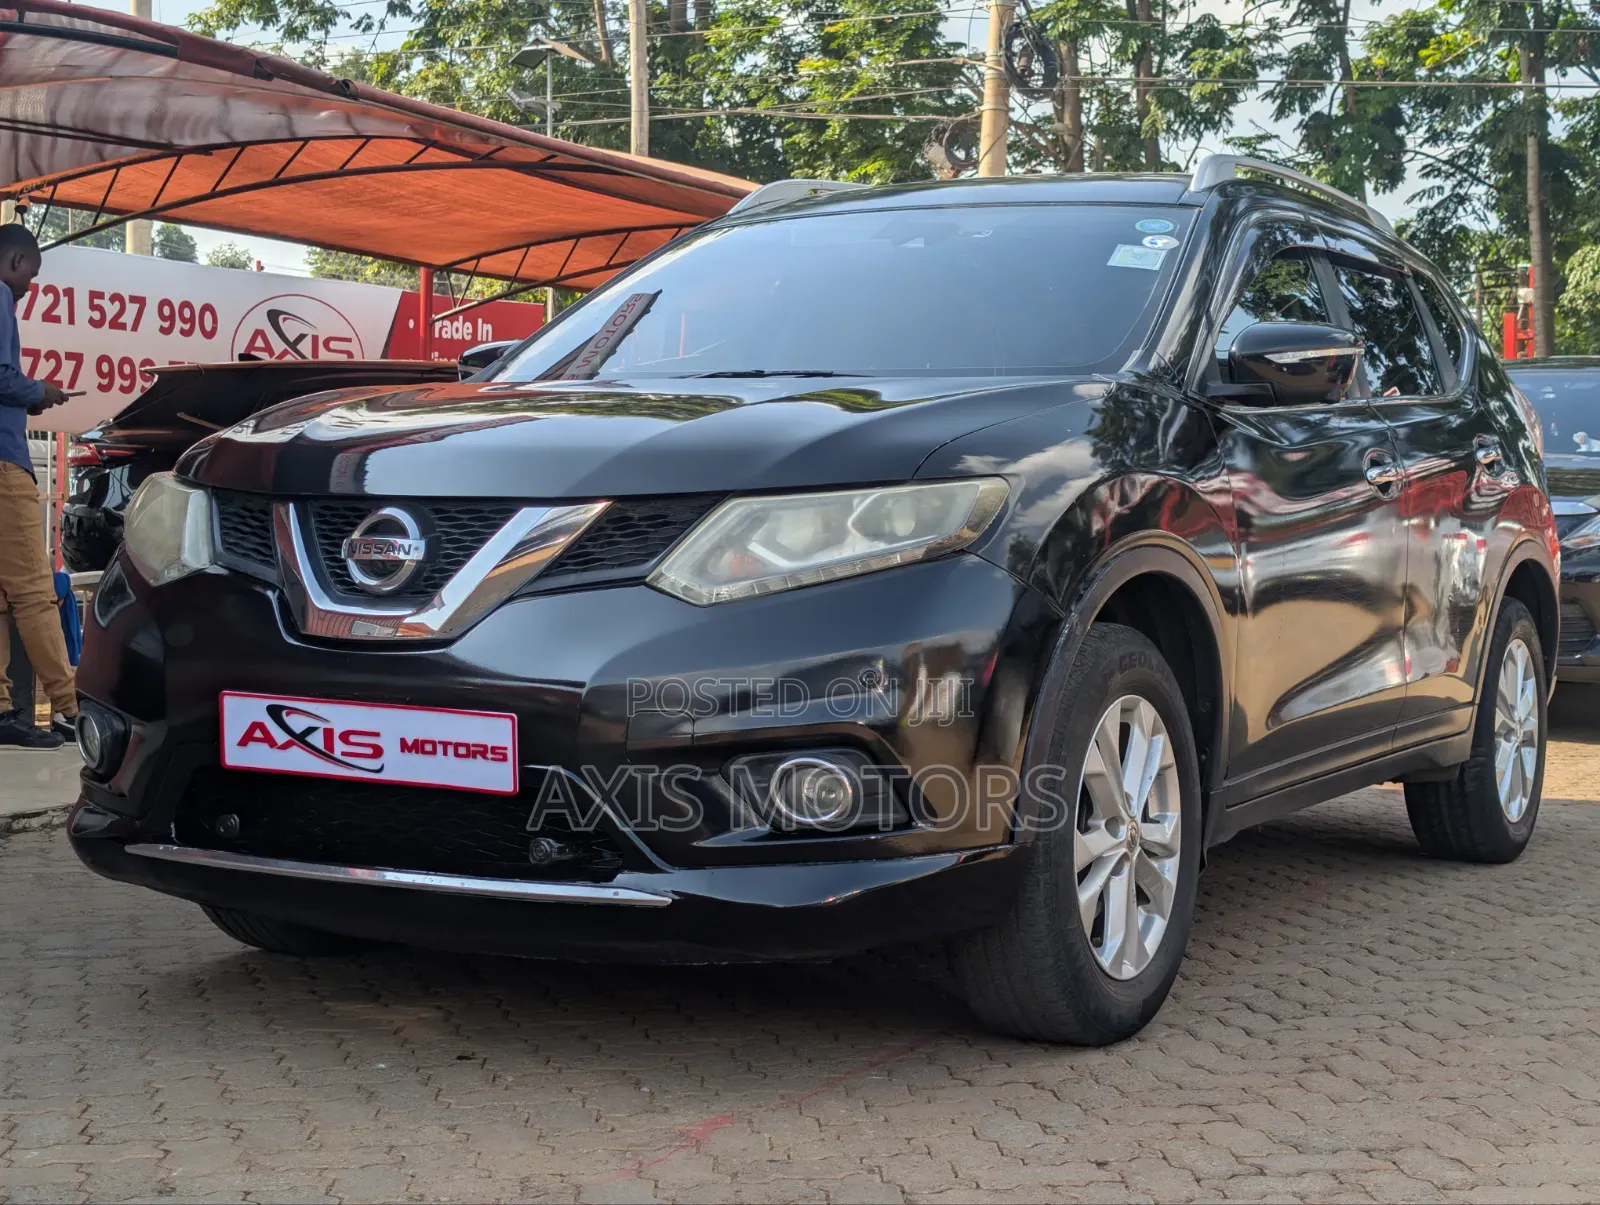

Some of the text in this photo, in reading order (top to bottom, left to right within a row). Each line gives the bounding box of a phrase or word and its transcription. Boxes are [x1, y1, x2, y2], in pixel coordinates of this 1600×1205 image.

[14, 283, 219, 340] 721 527 990
[430, 314, 493, 341] rade In
[242, 314, 355, 360] AXIS
[347, 543, 412, 556] NISSAN
[237, 709, 509, 770] AXIS MOTORS
